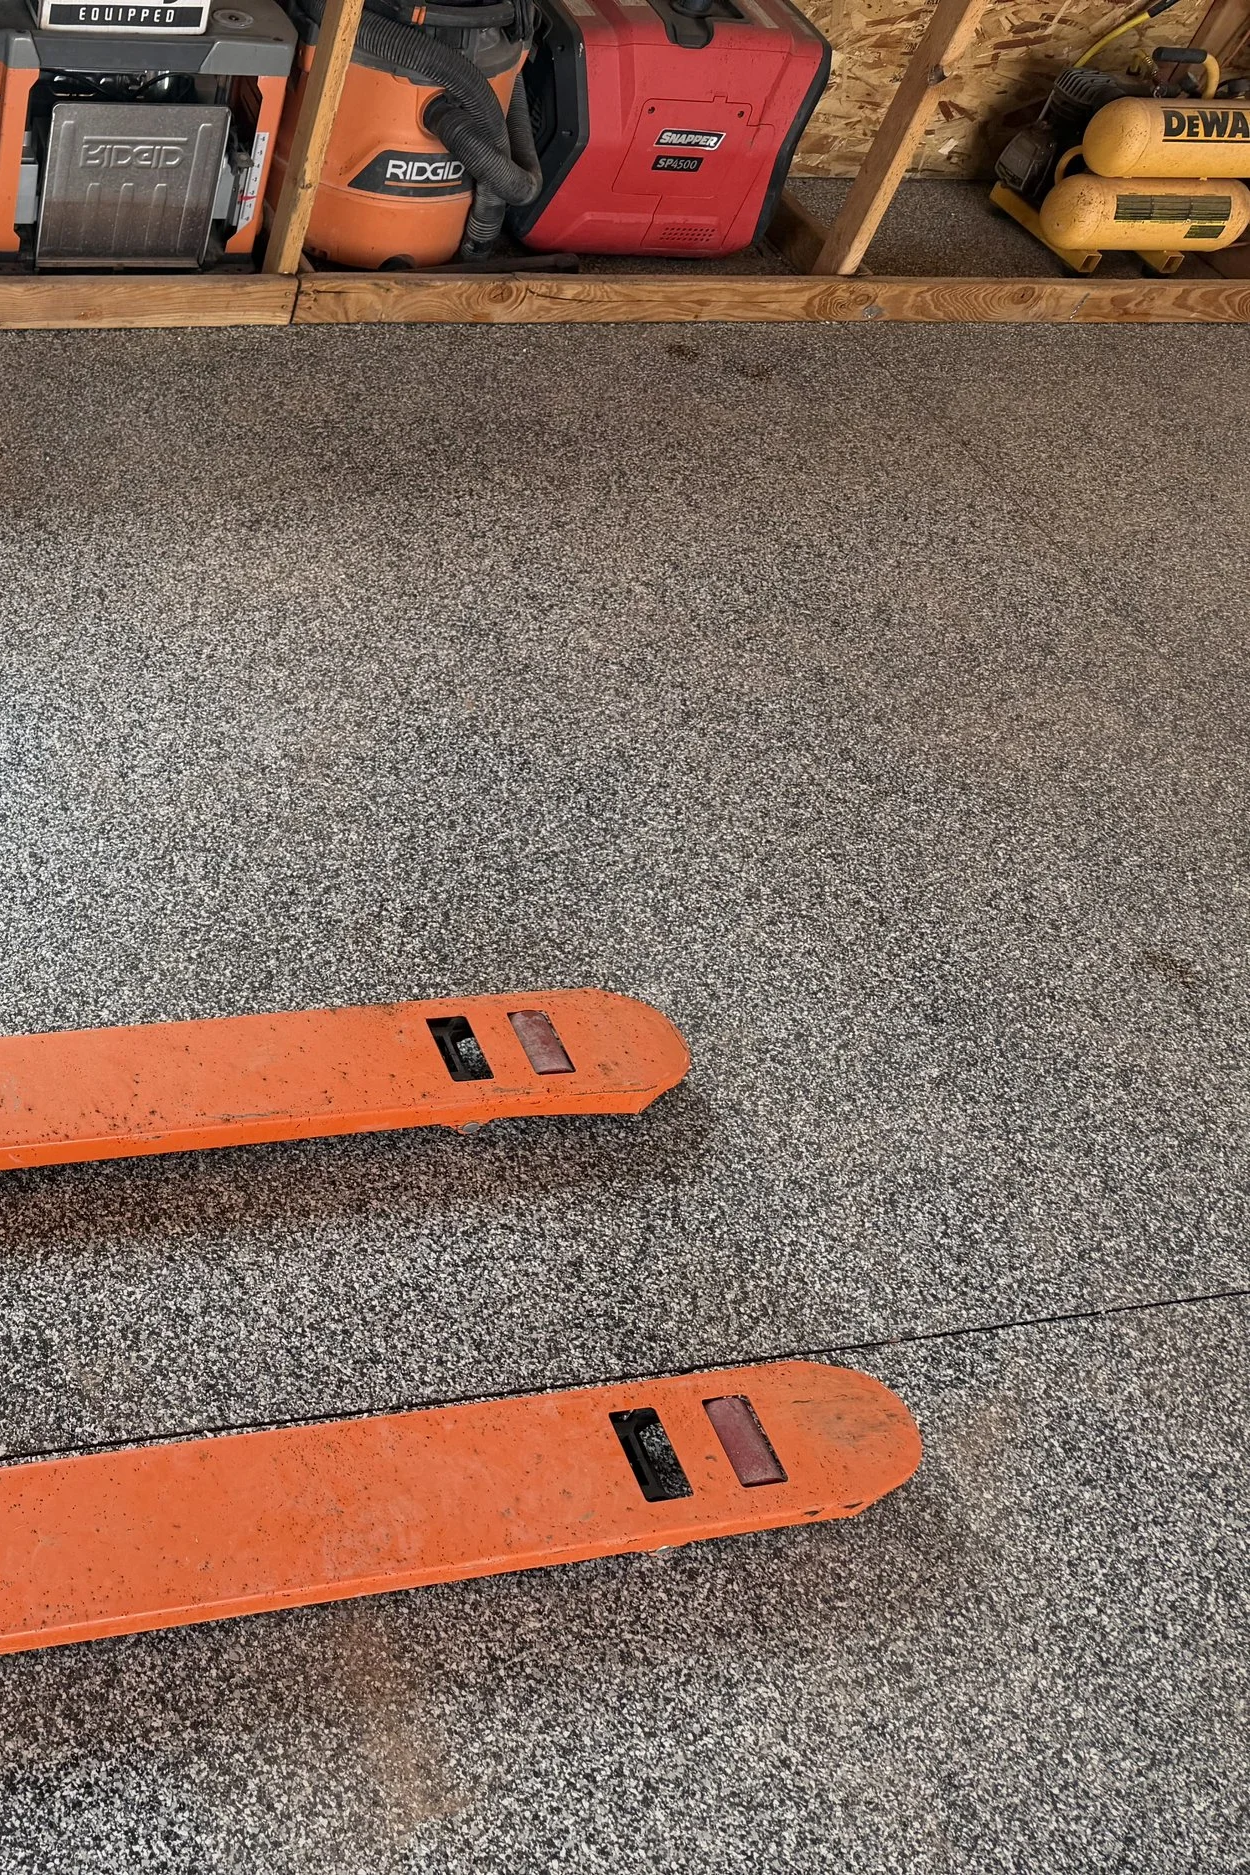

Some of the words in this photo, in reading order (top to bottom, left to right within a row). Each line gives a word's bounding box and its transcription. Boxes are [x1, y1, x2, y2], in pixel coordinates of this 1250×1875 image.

[79, 7, 175, 23] EQUIPPED
[659, 131, 718, 147] SNAPPER
[386, 159, 466, 181] RIDGID
[656, 158, 698, 170] SP4500
